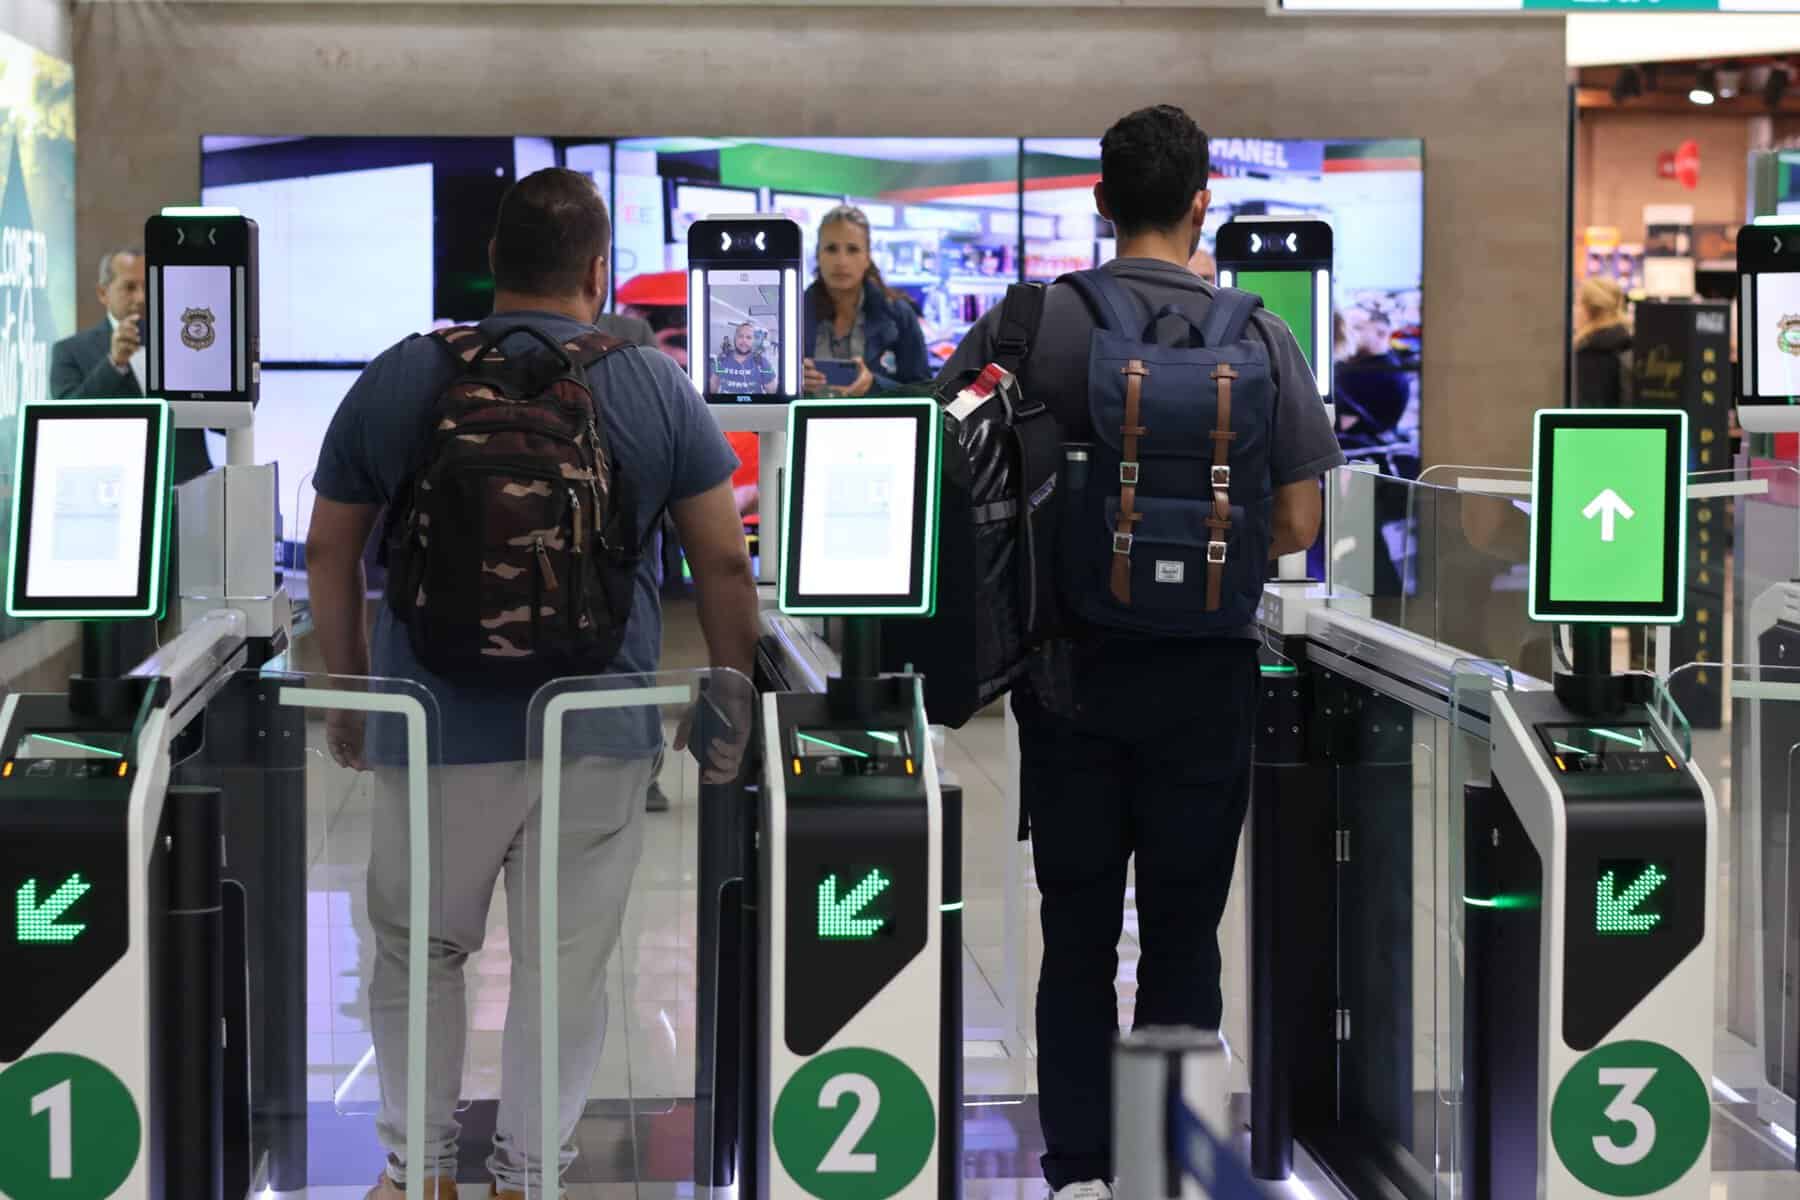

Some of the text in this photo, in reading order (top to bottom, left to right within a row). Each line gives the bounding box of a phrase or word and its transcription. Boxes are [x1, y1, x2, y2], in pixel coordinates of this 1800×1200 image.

[1207, 138, 1288, 169] HANEL
[0, 226, 33, 287] COME
[1697, 497, 1712, 585] OSTA
[31, 1079, 72, 1178] 1
[816, 1073, 880, 1172] 2
[1592, 1068, 1658, 1165] 3
